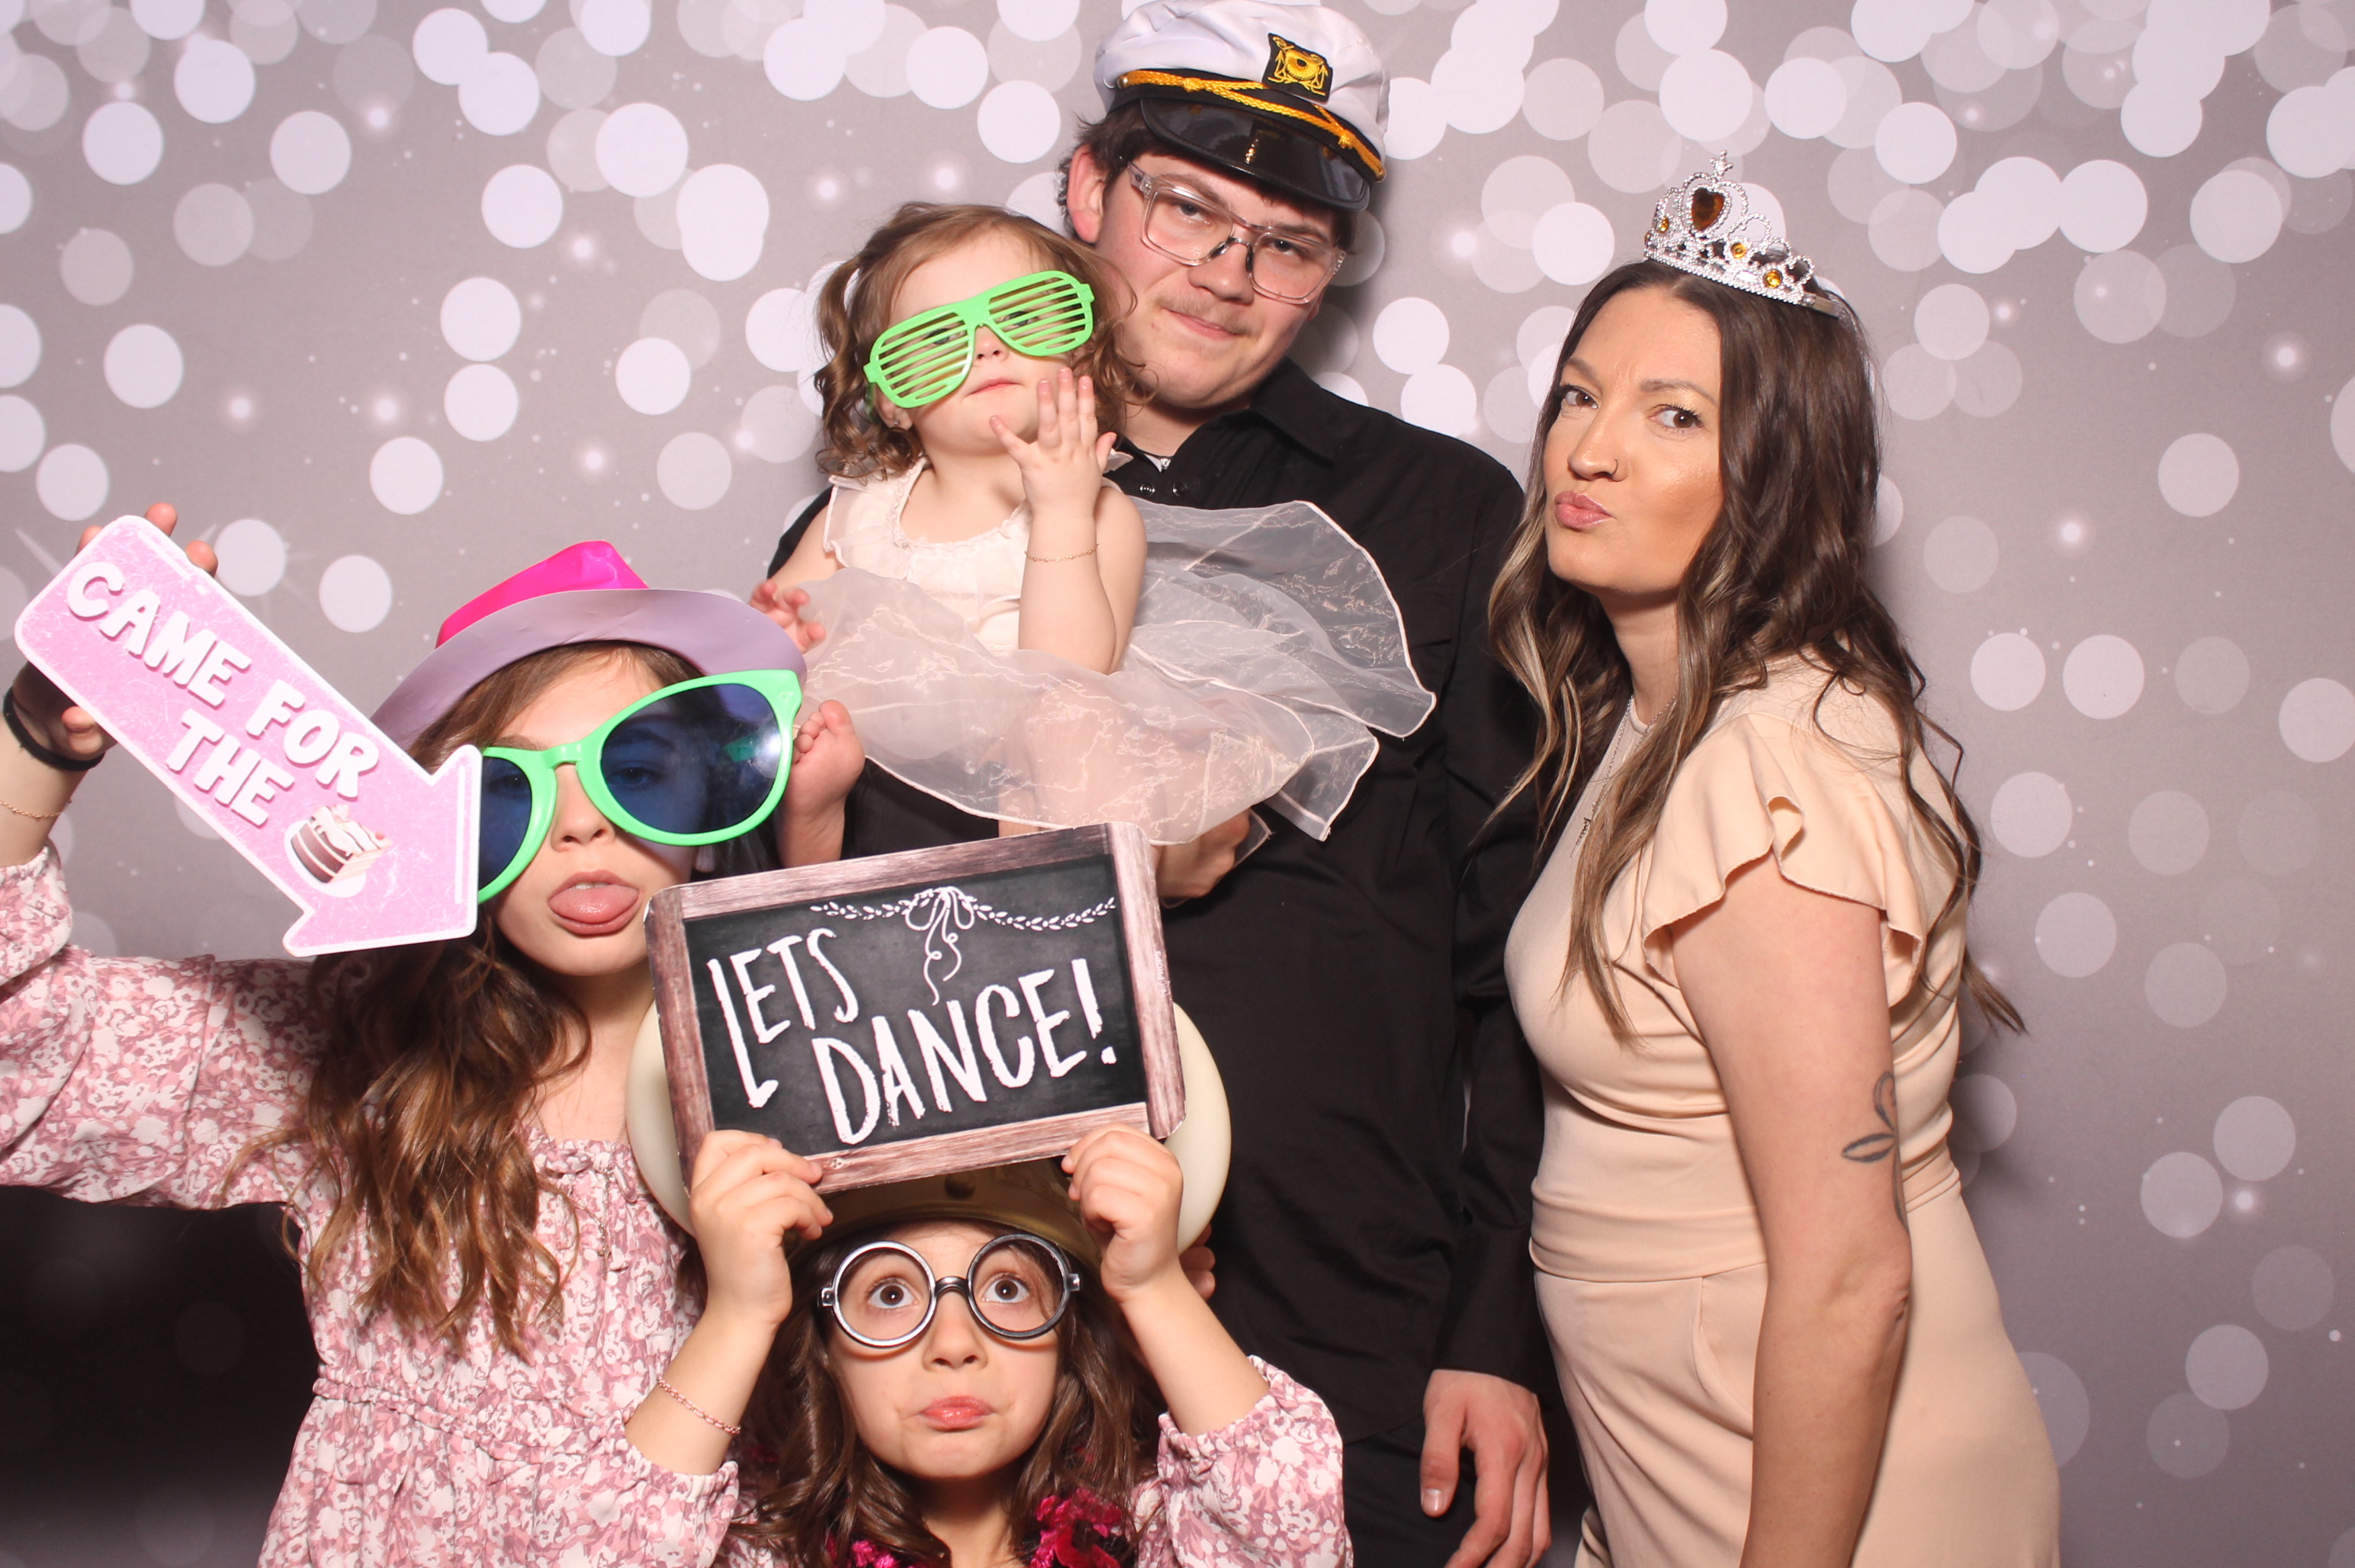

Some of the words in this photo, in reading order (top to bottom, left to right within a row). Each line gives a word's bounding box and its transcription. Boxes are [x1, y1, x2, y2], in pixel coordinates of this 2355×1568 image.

[67, 561, 252, 707] CAME
[245, 679, 381, 798] FOR
[165, 708, 296, 827] THE
[706, 927, 860, 1109] LETS
[811, 958, 1117, 1145] DANCE!
[1154, 950, 1165, 981] PROPS
